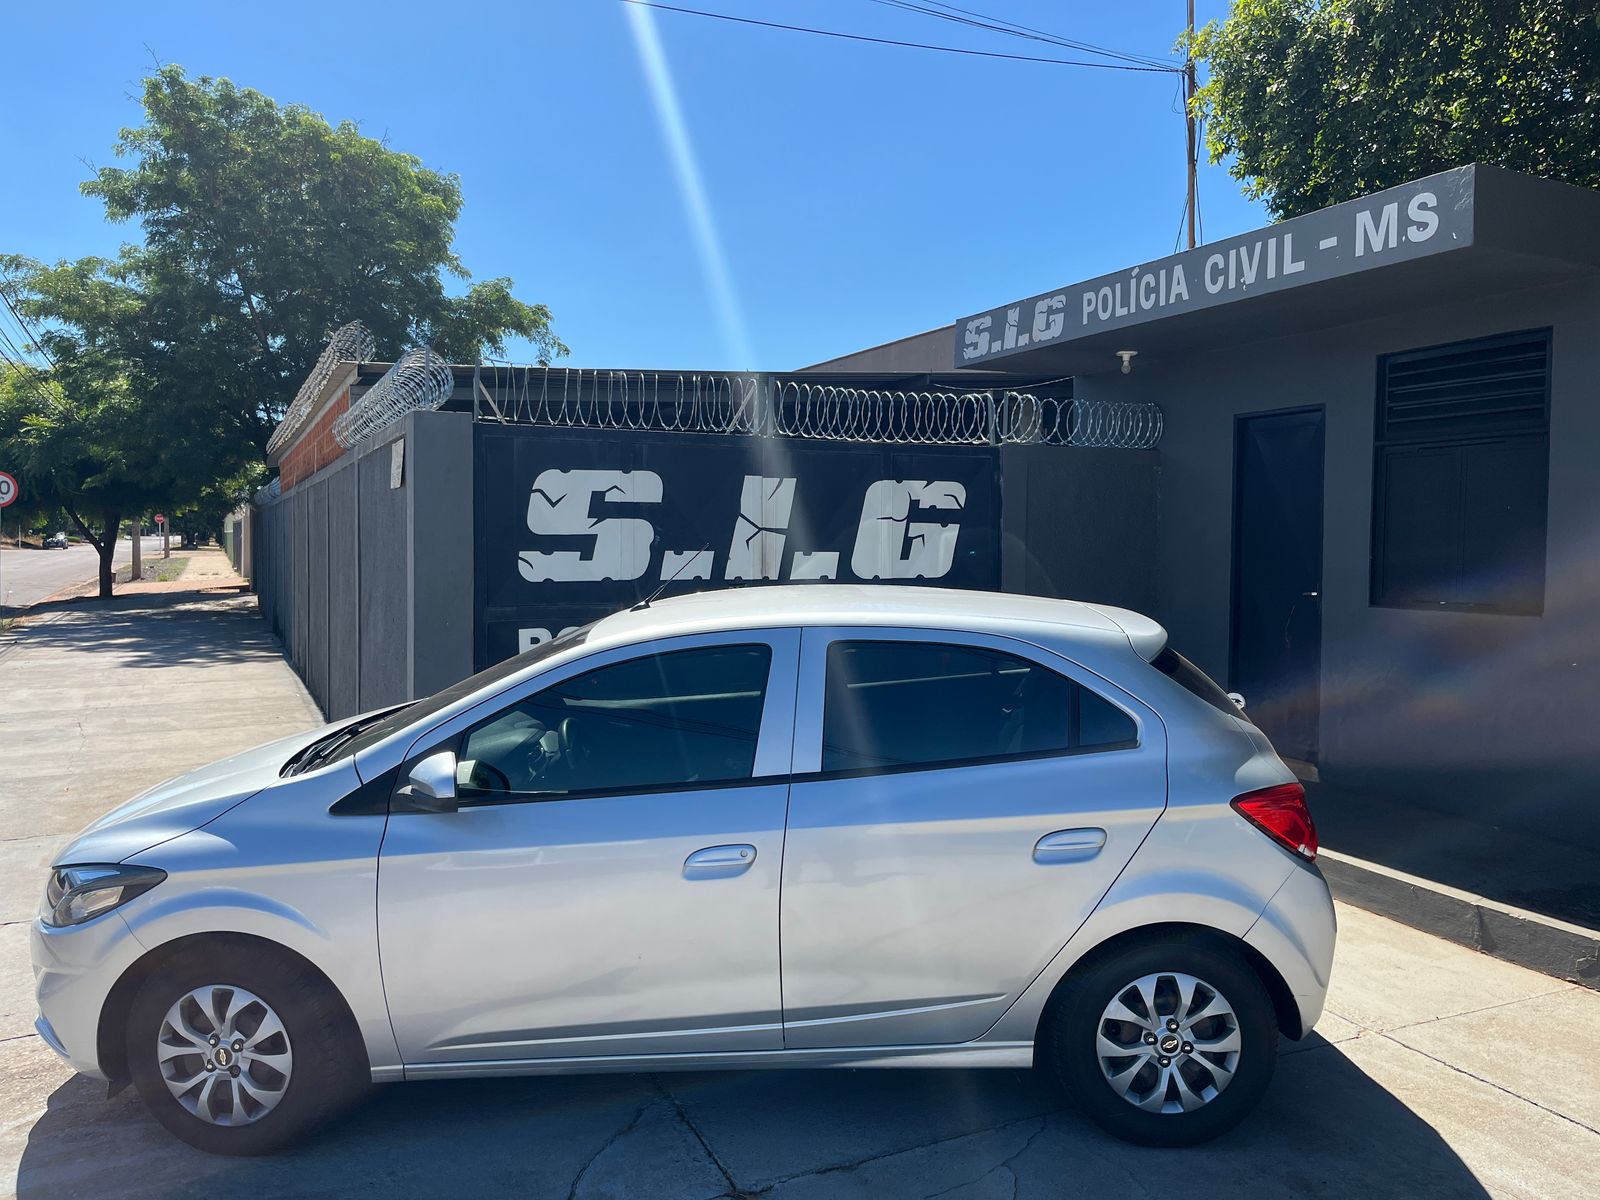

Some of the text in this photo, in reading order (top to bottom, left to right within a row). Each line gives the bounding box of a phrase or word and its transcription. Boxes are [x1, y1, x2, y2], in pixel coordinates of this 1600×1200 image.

[963, 192, 1440, 360] S.I.G POLÍCIA CIVIL - MS
[517, 468, 967, 583] S.I.G
